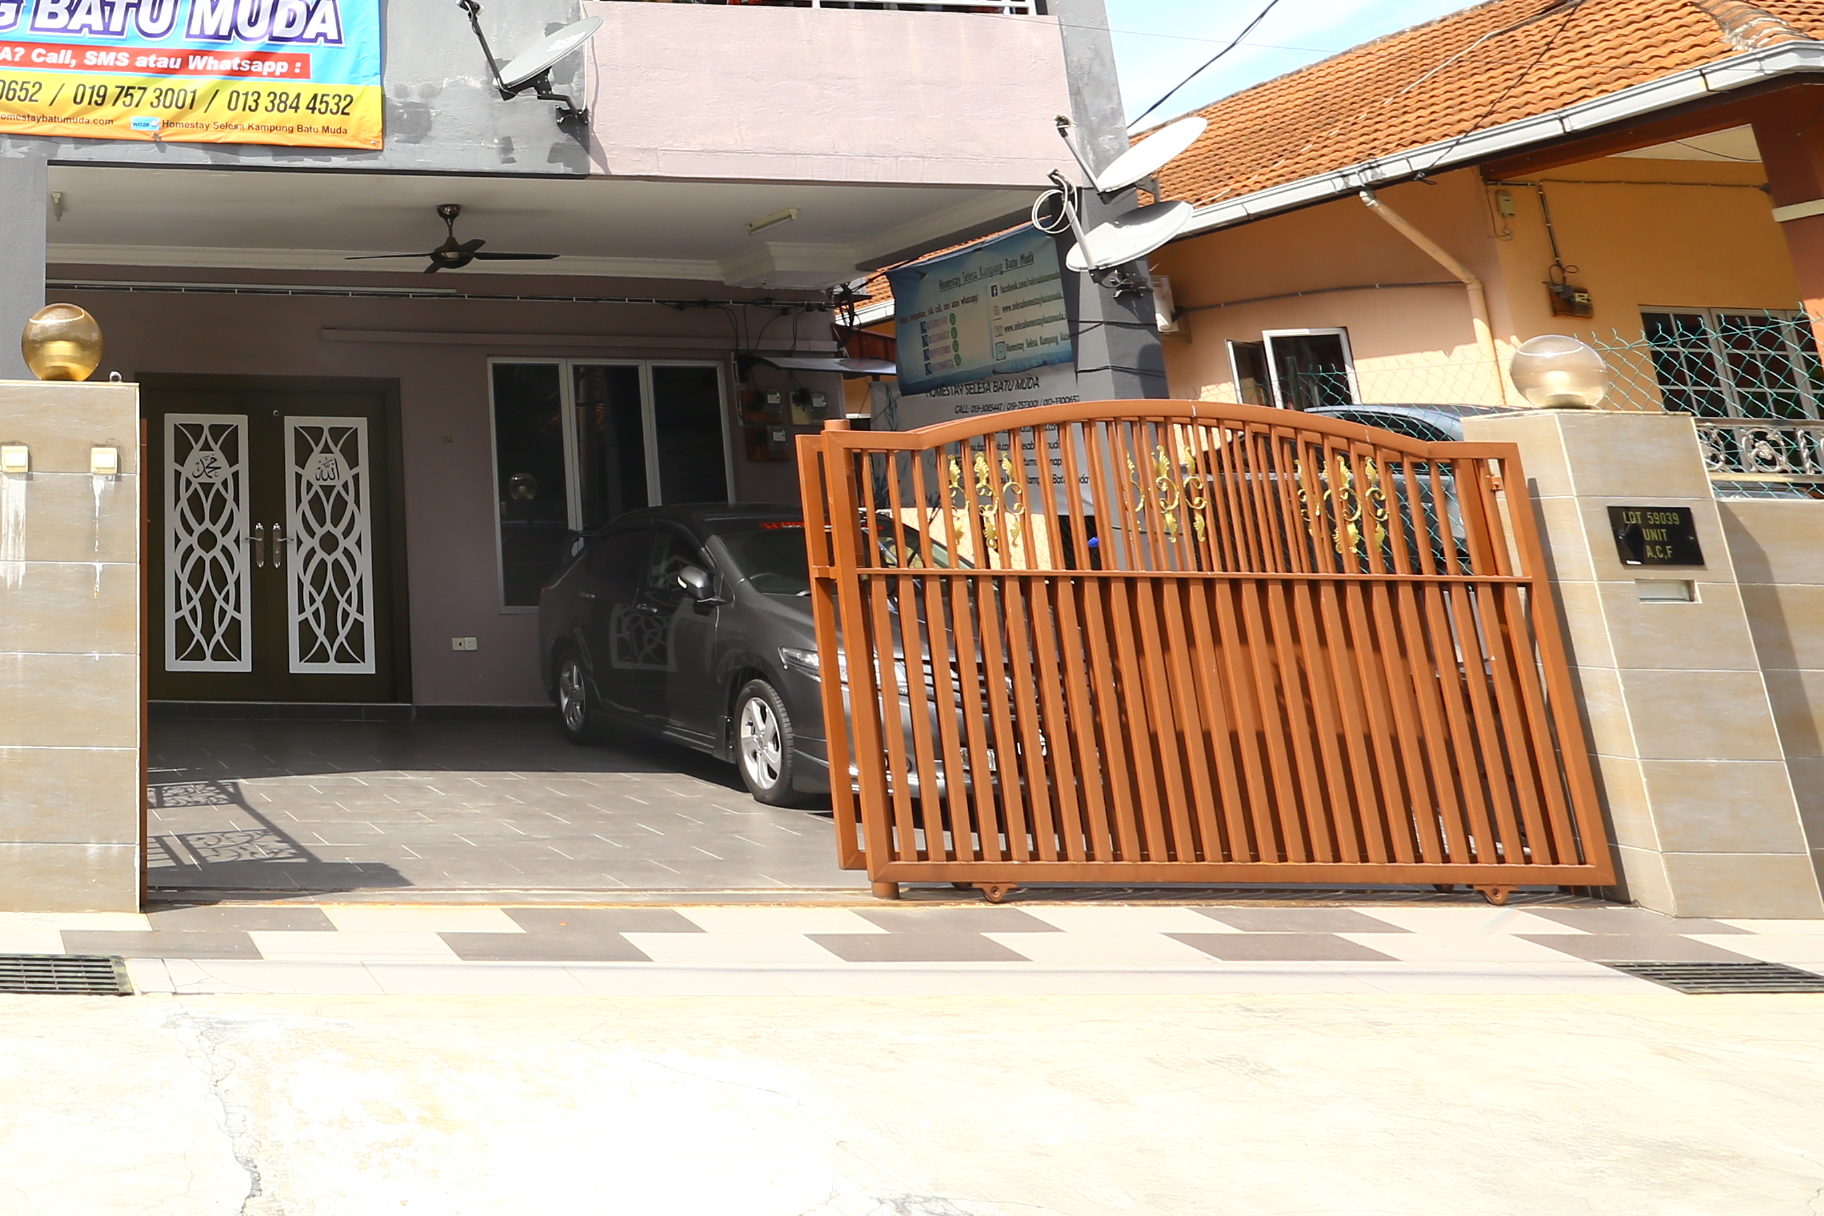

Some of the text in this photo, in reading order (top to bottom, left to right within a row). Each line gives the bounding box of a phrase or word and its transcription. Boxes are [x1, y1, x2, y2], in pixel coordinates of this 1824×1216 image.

[31, 48, 77, 68] Call,
[83, 51, 129, 67] SMS
[135, 54, 182, 70] atau
[187, 55, 289, 77] Whatsapp
[72, 83, 108, 107] 019
[111, 85, 149, 109] 757
[149, 87, 197, 110] 3001
[227, 90, 261, 113] 013
[264, 91, 301, 114] 384
[305, 92, 354, 116] 4532
[162, 119, 348, 135] Homestay Selesa Kampung Batu Muda
[965, 381, 991, 395] SELESA
[993, 379, 1013, 392] BATU
[1015, 376, 1040, 391] MUDA
[1623, 511, 1680, 525] LOT 59039
[1642, 528, 1667, 541] UNIT
